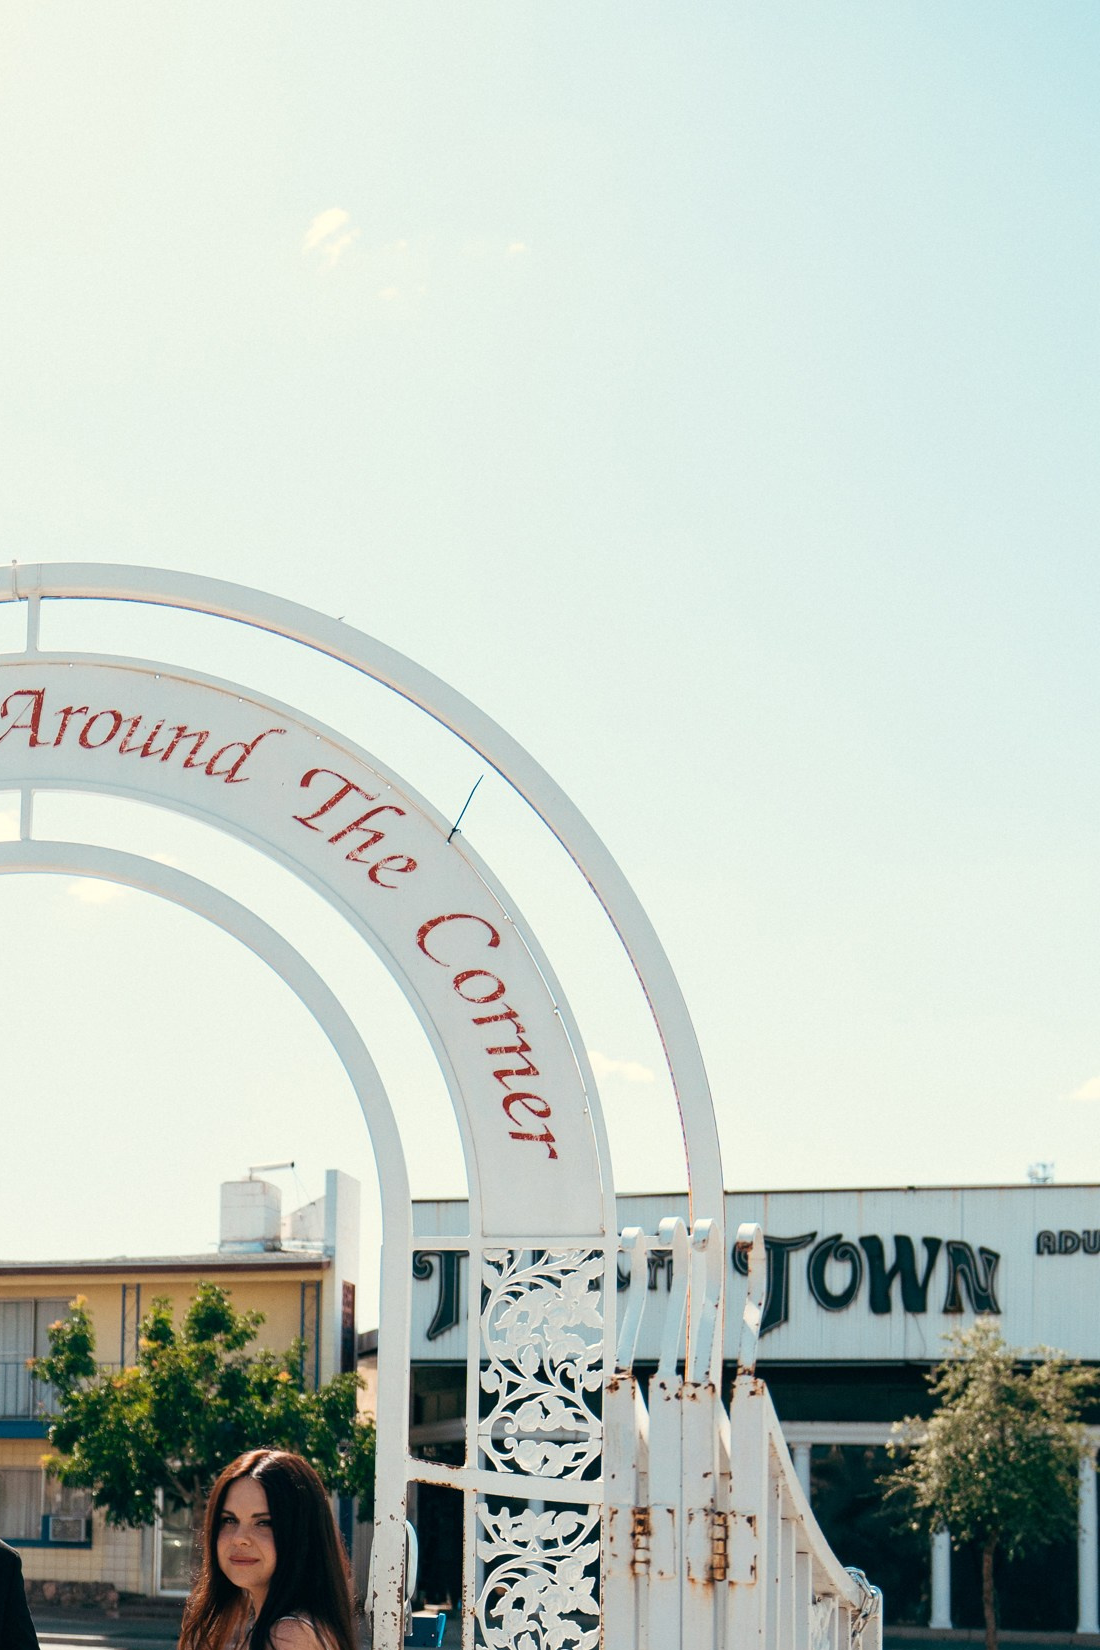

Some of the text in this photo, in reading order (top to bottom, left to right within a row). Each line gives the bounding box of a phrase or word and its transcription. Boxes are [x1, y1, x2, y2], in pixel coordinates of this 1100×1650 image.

[293, 767, 418, 889] The
[416, 913, 558, 1160] Corner
[732, 1231, 1002, 1338] TOWN
